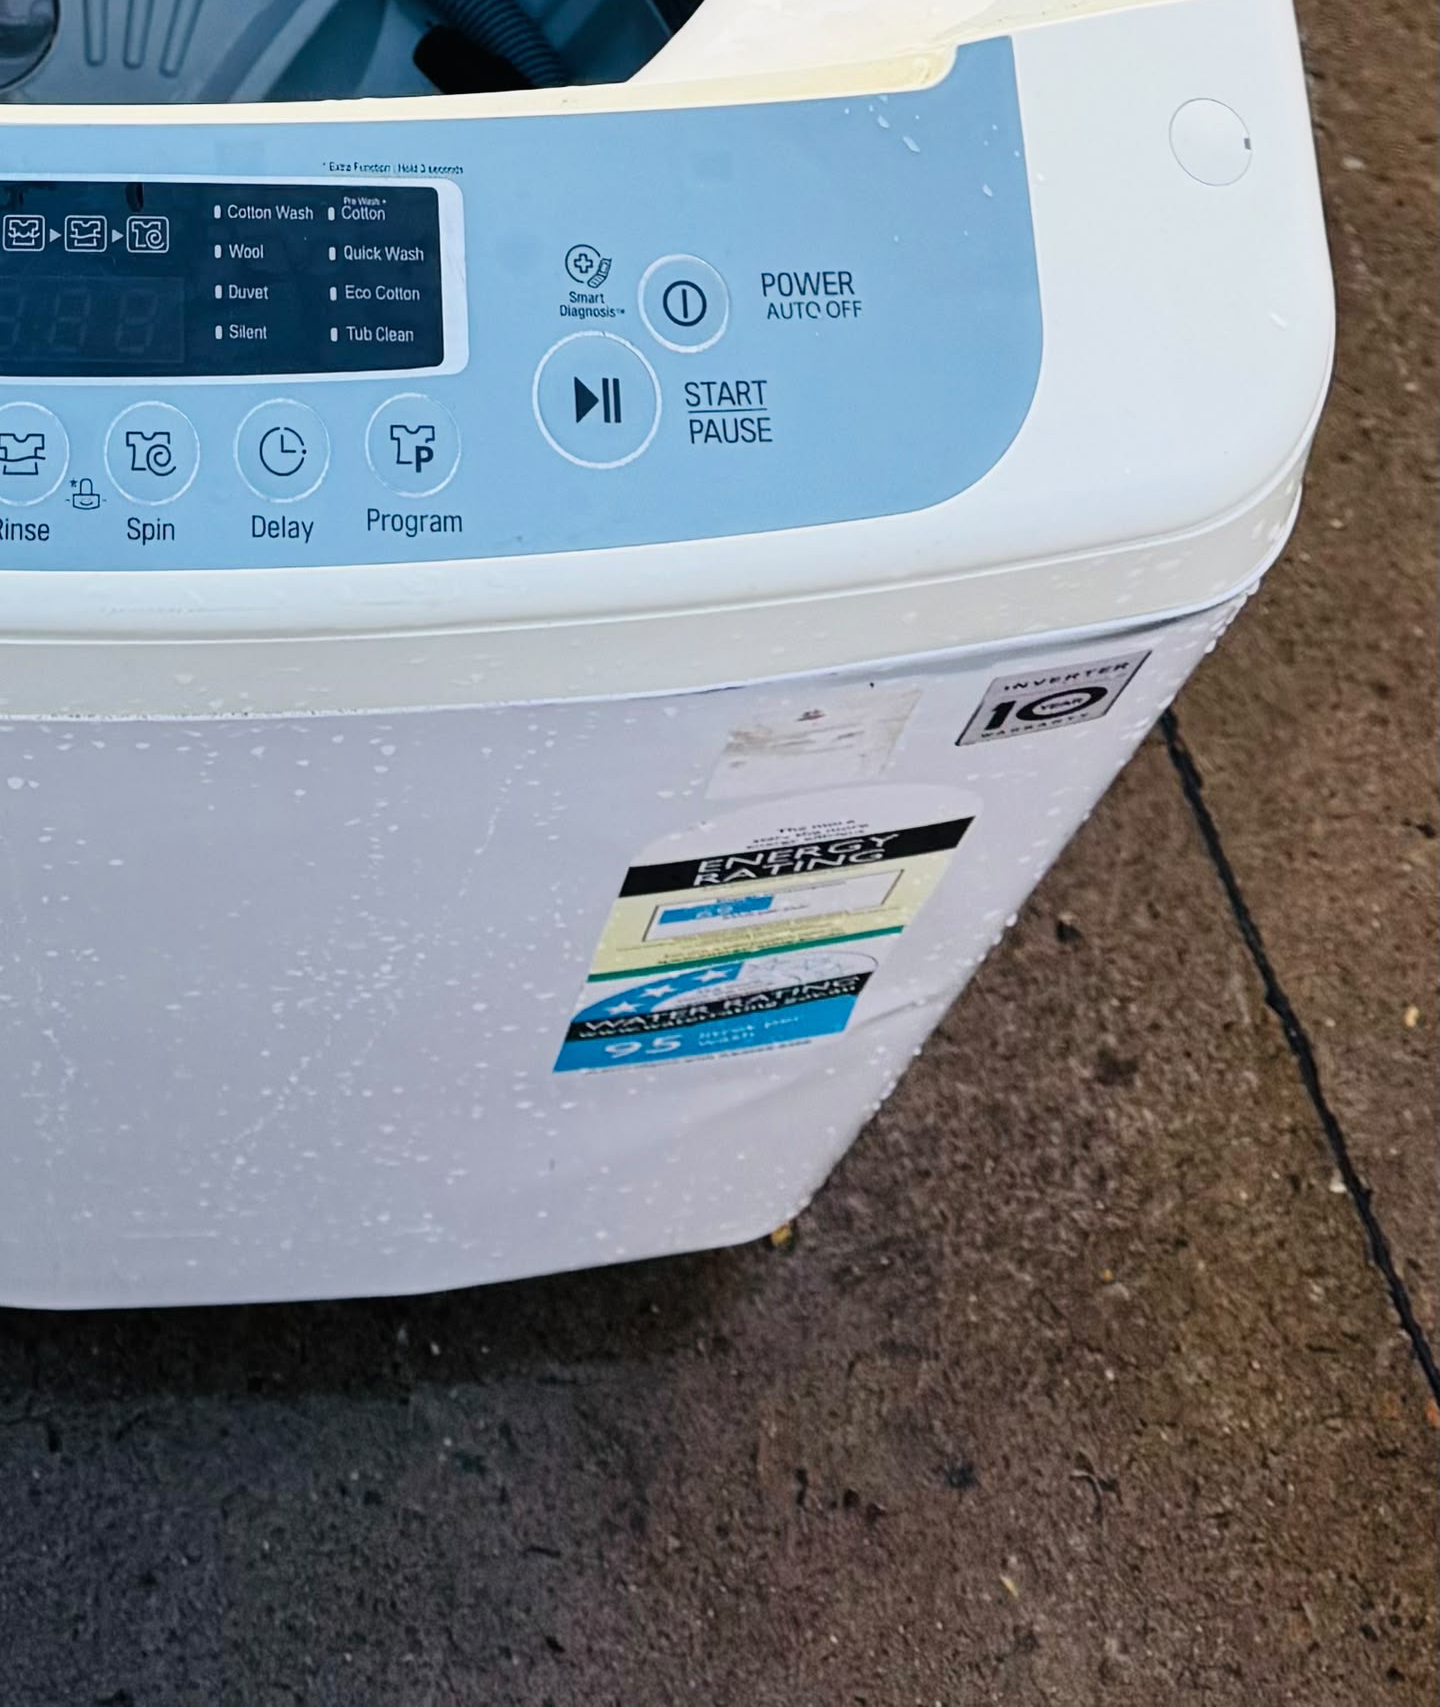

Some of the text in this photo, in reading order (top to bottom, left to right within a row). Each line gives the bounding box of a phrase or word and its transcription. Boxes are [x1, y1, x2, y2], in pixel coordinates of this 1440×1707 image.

[227, 205, 314, 221] Cotton Wash
[341, 205, 386, 221] Cotton
[229, 244, 264, 260] Wool
[344, 245, 424, 262] Quick Wash
[228, 285, 269, 300] Duvet
[345, 286, 420, 301] Eco Cotton
[761, 271, 855, 298] POWER
[569, 291, 605, 304] Smart
[767, 301, 862, 319] AUTO OFF
[228, 324, 268, 340] Silent
[346, 326, 414, 342] Tub Clean
[685, 380, 768, 407] START
[689, 418, 773, 444] PAUSE
[127, 518, 175, 545] Spin
[252, 516, 314, 544] Delay
[367, 509, 463, 537] Program
[1004, 662, 1130, 691] INVERTER
[984, 686, 1108, 731] 10
[699, 833, 898, 873] ENERGY
[693, 852, 886, 886] RATING
[585, 1005, 710, 1030] WATER
[723, 976, 860, 1010] RATING
[604, 1034, 682, 1059] 95
